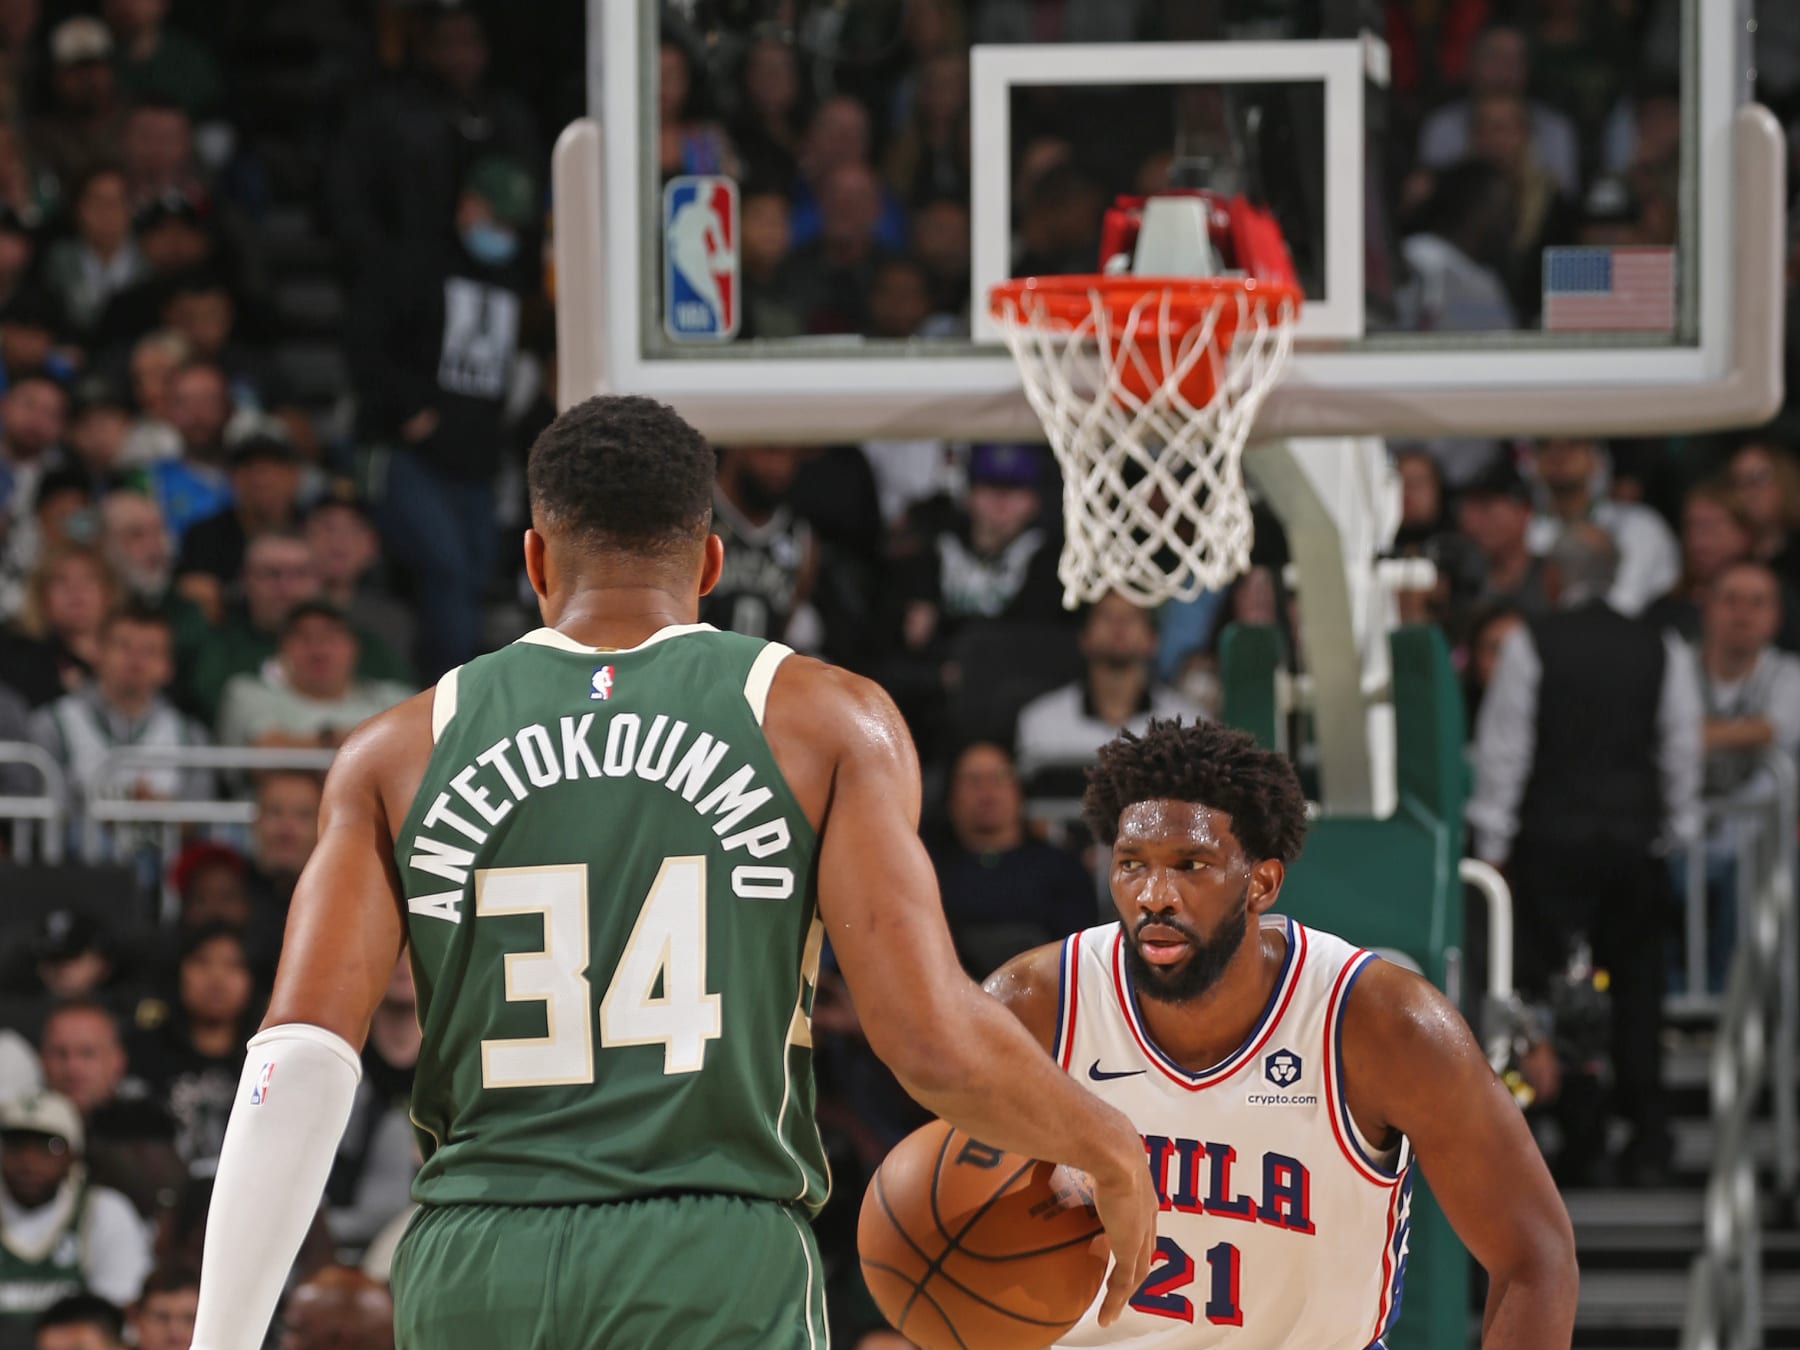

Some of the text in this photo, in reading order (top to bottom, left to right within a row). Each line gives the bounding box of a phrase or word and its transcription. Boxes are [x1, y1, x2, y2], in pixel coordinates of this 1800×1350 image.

[408, 713, 794, 924] ANTETOKOUNMPO
[474, 855, 722, 1089] 34
[1247, 1094, 1318, 1105] crypto.com
[1128, 1235, 1244, 1328] 21
